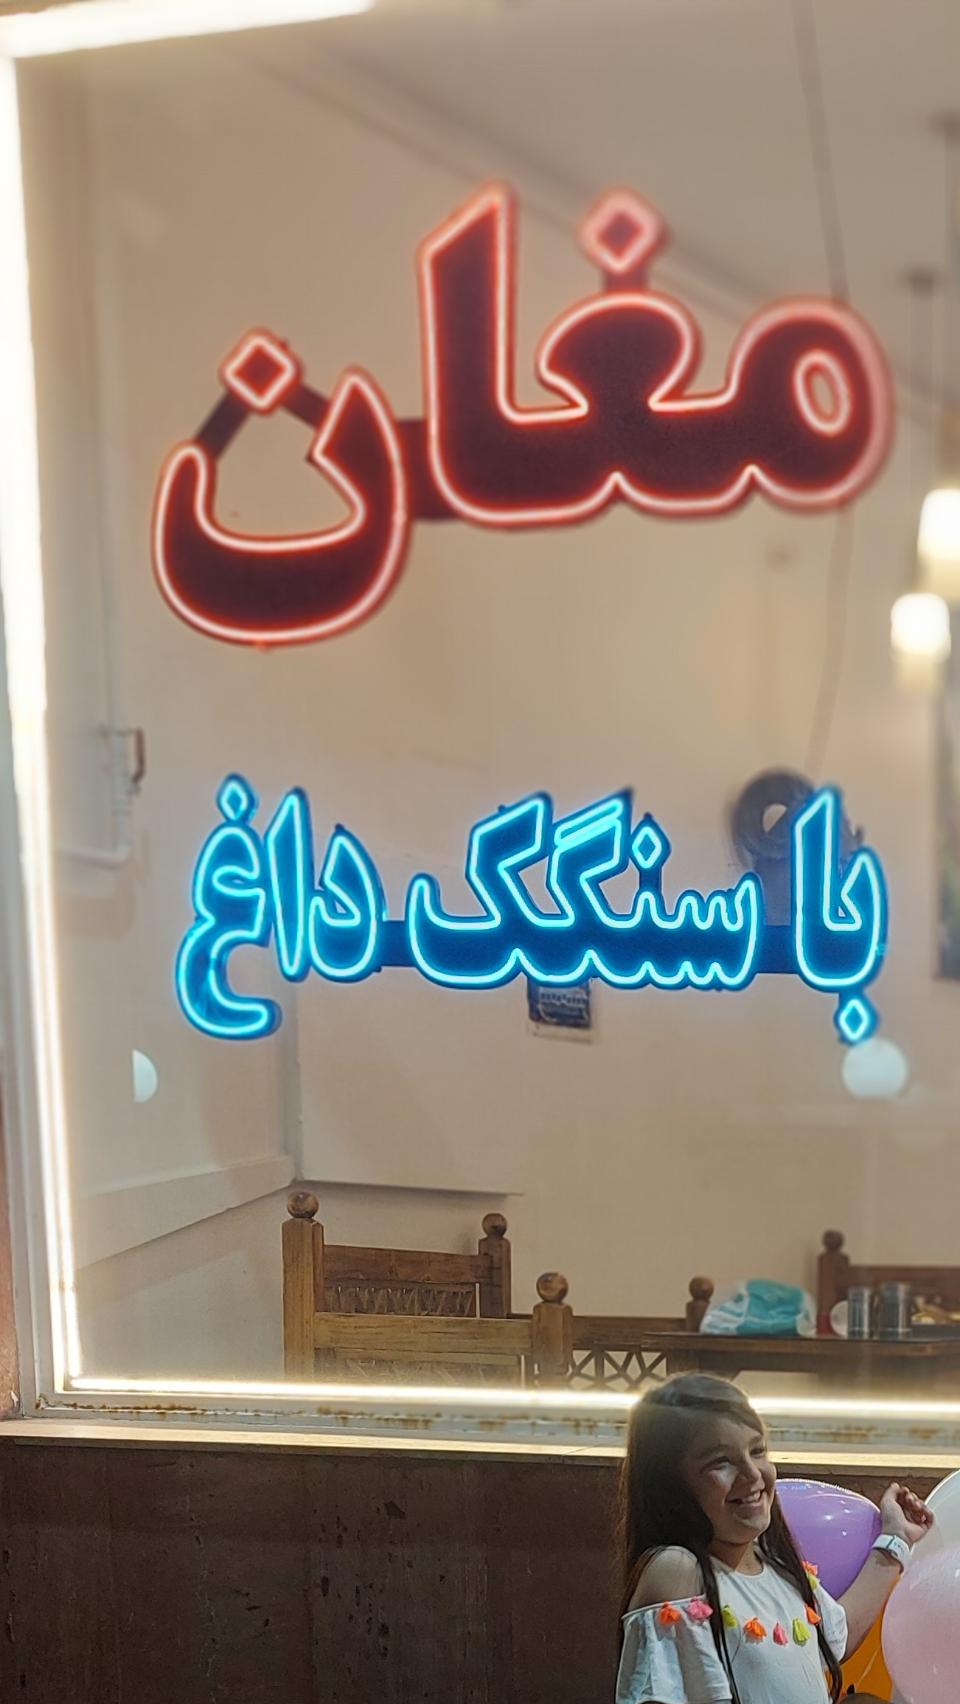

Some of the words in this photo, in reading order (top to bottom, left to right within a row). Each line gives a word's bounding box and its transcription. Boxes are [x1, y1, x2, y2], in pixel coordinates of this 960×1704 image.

[154, 180, 893, 646] مغان
[177, 774, 381, 1038] داغ
[408, 788, 761, 990] سنگک
[793, 783, 889, 1043] با
